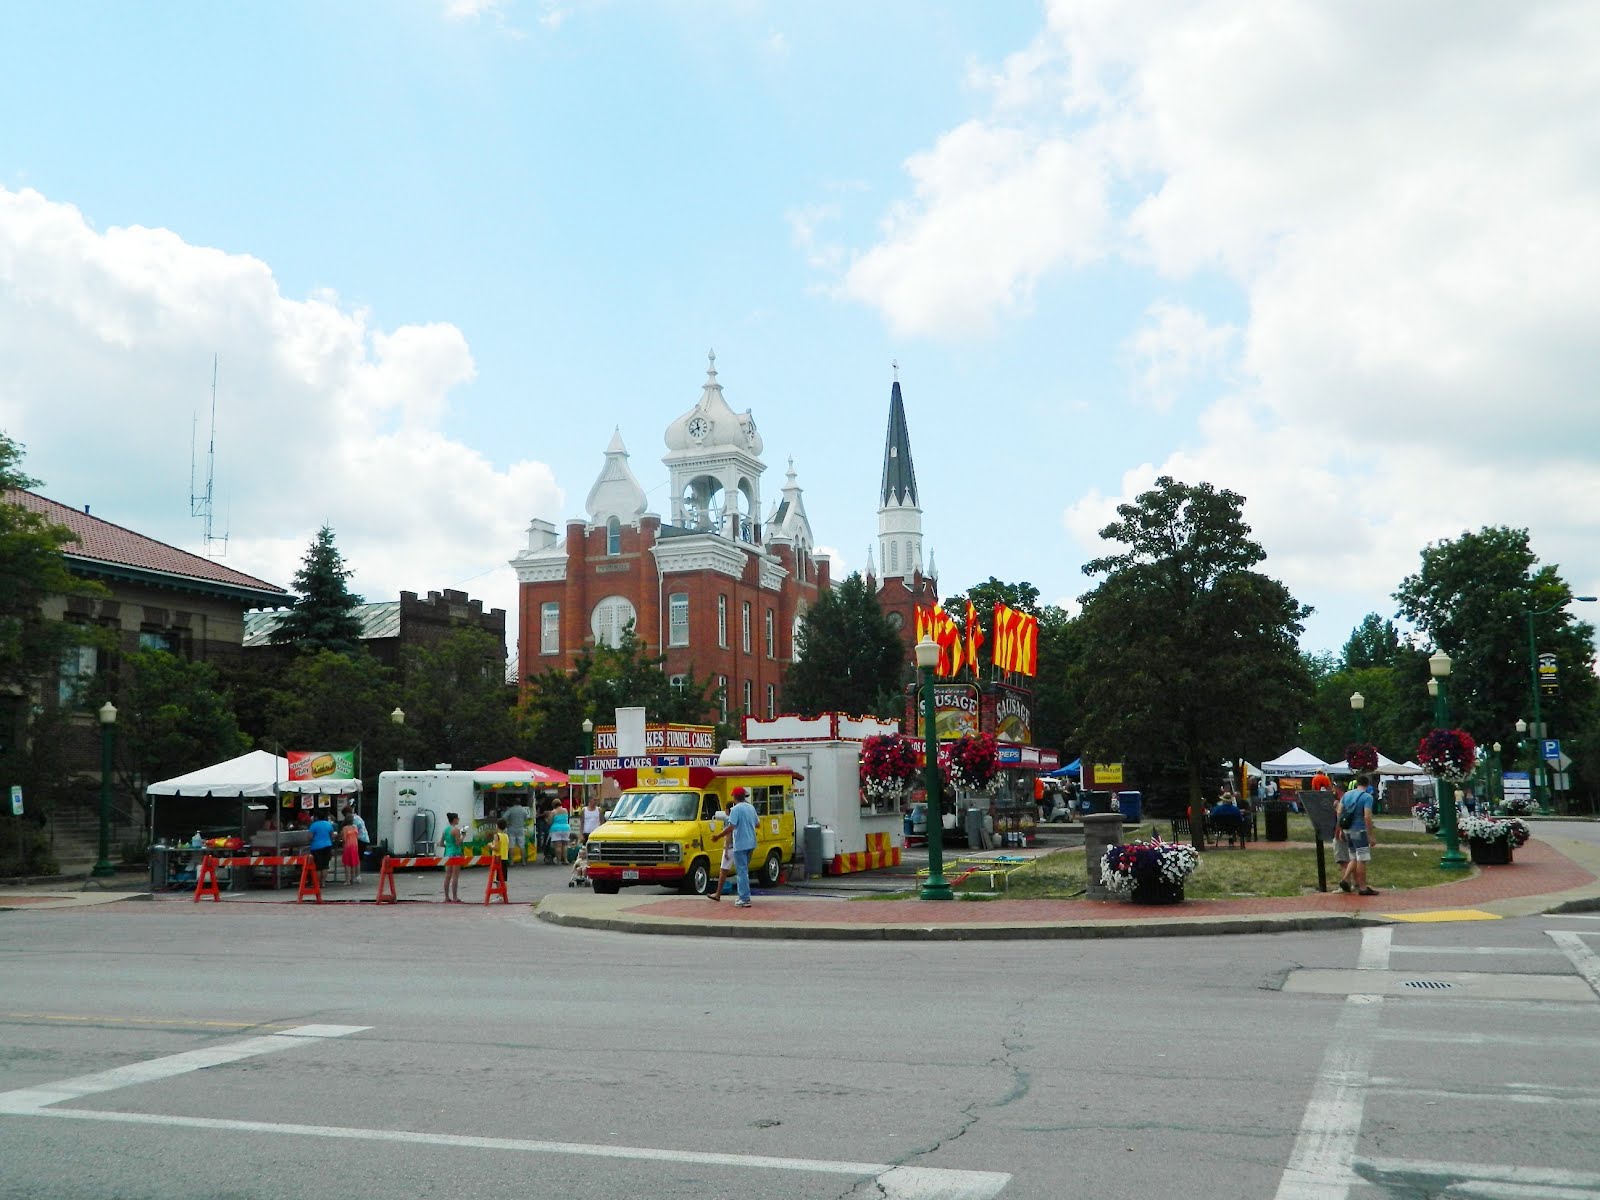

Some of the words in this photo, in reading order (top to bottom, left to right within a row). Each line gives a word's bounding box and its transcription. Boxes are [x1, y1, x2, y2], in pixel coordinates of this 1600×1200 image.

[920, 694, 977, 715] SUSAGE
[996, 698, 1031, 730] SAUSAGE
[597, 733, 618, 749] FUN
[666, 731, 691, 748] FUNNEL
[692, 732, 713, 749] CAKES
[1545, 741, 1556, 752] P
[589, 759, 622, 770] FUNNEL
[623, 757, 652, 769] CAKES
